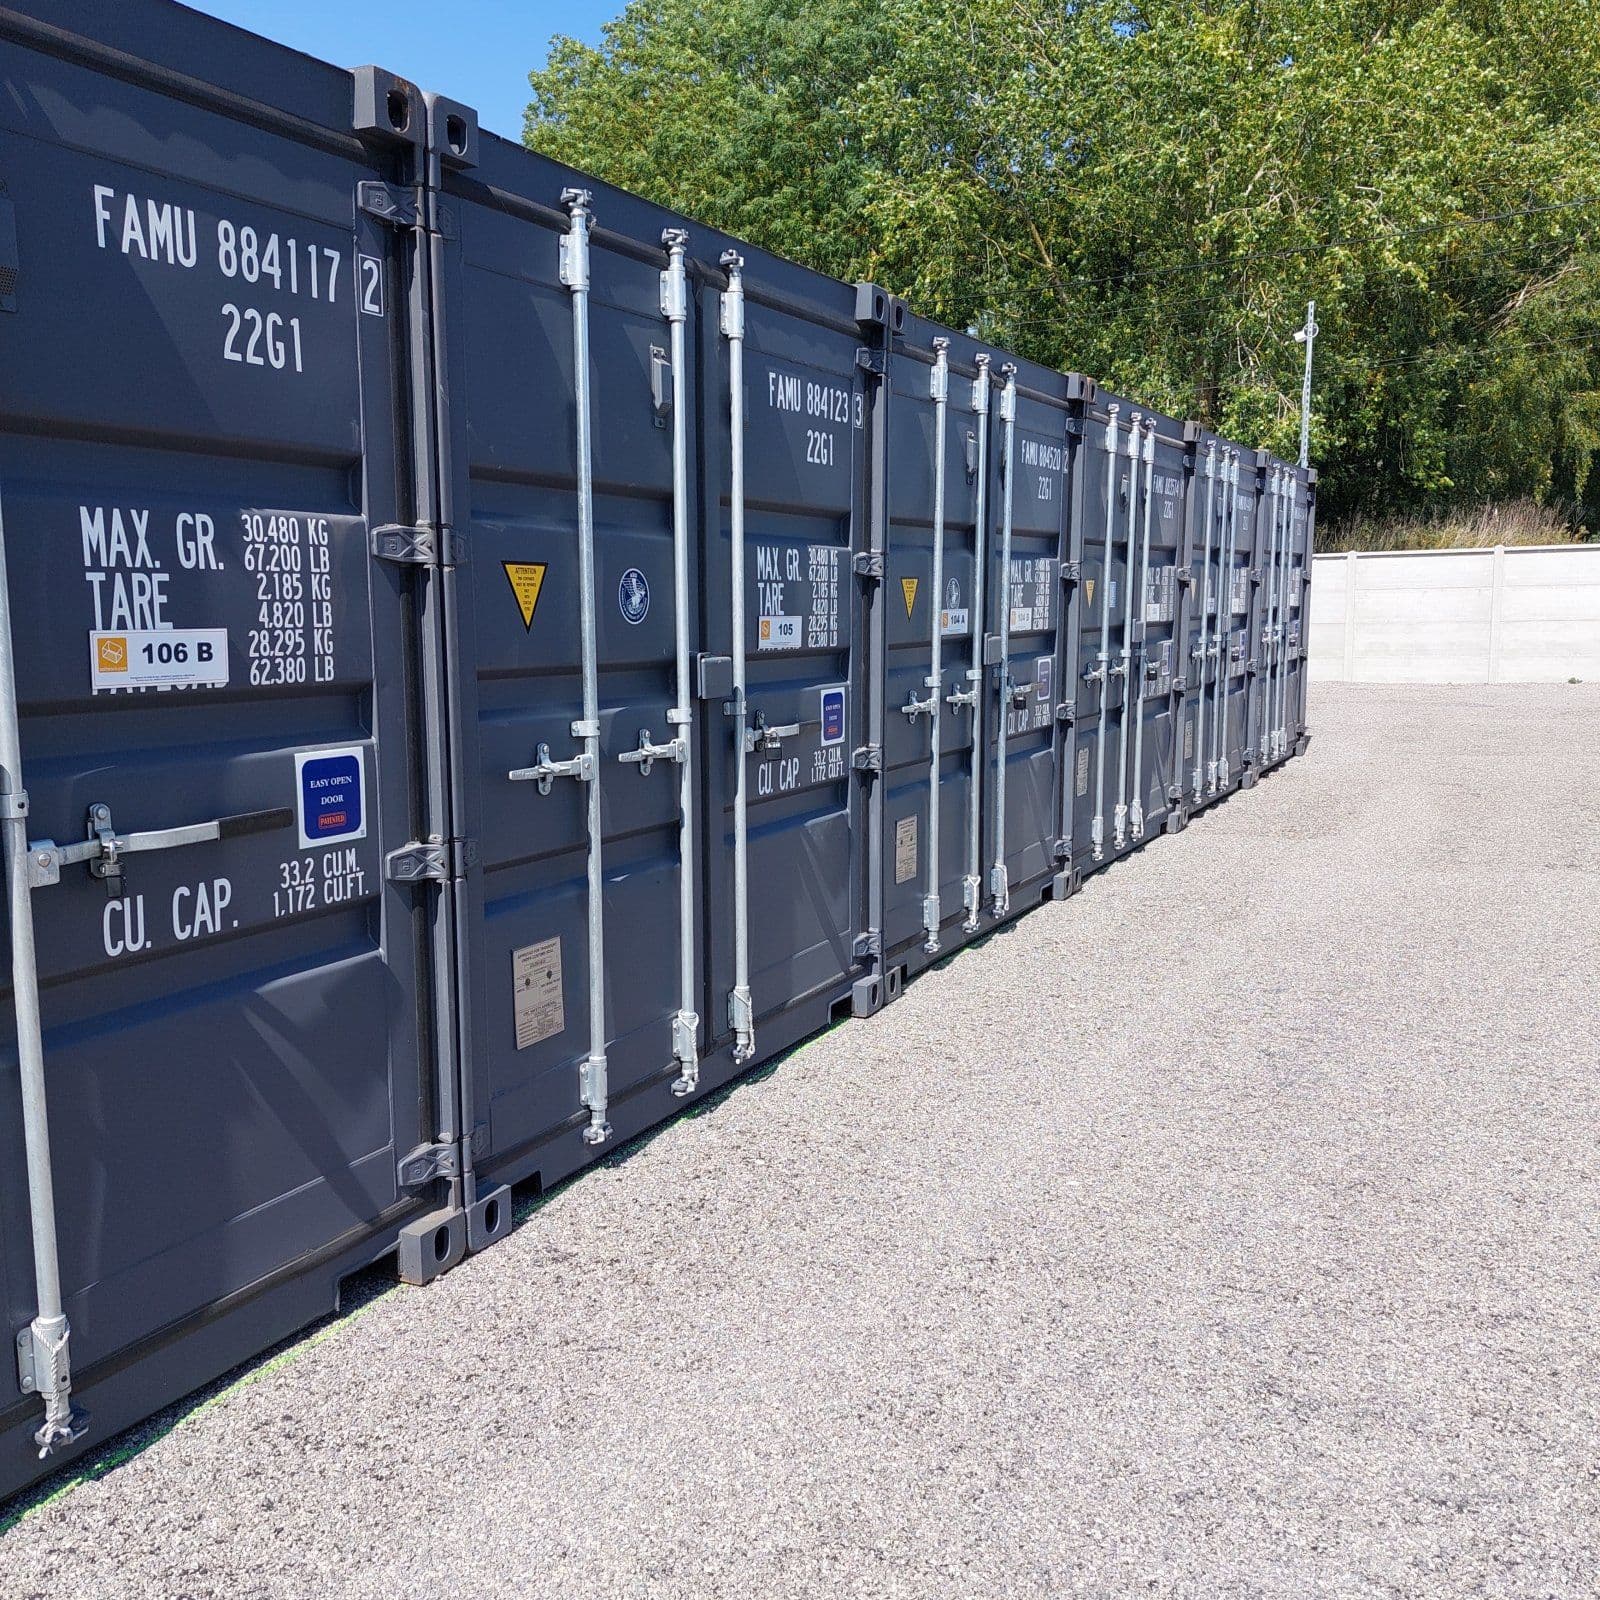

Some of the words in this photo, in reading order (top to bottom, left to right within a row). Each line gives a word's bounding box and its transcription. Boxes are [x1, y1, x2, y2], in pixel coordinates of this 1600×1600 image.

[94, 184, 197, 267] FAMU
[217, 219, 341, 303] 884117
[361, 258, 381, 313] 2
[221, 303, 303, 373] 22G1
[769, 371, 801, 412] FAMU
[806, 382, 849, 424] 884123
[806, 429, 833, 466] 22G1
[1021, 439, 1039, 466] FAMU
[79, 505, 161, 569] MAX.
[175, 512, 225, 570] GR.
[240, 514, 299, 544] 30,480
[307, 518, 329, 546] KG
[244, 544, 302, 573] 67,200
[309, 546, 331, 573] LB
[756, 545, 782, 581] MAX.
[786, 548, 802, 582] GR.
[85, 572, 174, 630] TARE
[256, 572, 303, 600] 2,185
[310, 573, 331, 600] KG
[258, 601, 304, 629] 4,820
[312, 601, 333, 628] LB
[757, 582, 785, 616] TARE
[247, 629, 305, 659] 28,295
[314, 628, 334, 655] KG
[778, 623, 793, 636] 105
[141, 642, 189, 664] 106
[197, 641, 214, 662] B
[249, 656, 306, 686] 62,380
[314, 656, 335, 682] LB
[309, 778, 330, 789] EASY
[330, 775, 352, 786] OPEN
[758, 762, 774, 795] CU.
[779, 757, 801, 791] CAP.
[320, 794, 344, 805] DOOR
[319, 815, 345, 827] PATENTED
[102, 894, 152, 958] CU.
[172, 877, 239, 942] CAP.
[279, 857, 315, 889] 33.2
[322, 847, 360, 879] CU.M.
[273, 883, 316, 917] 1,172
[323, 871, 369, 905] CU.FT.
